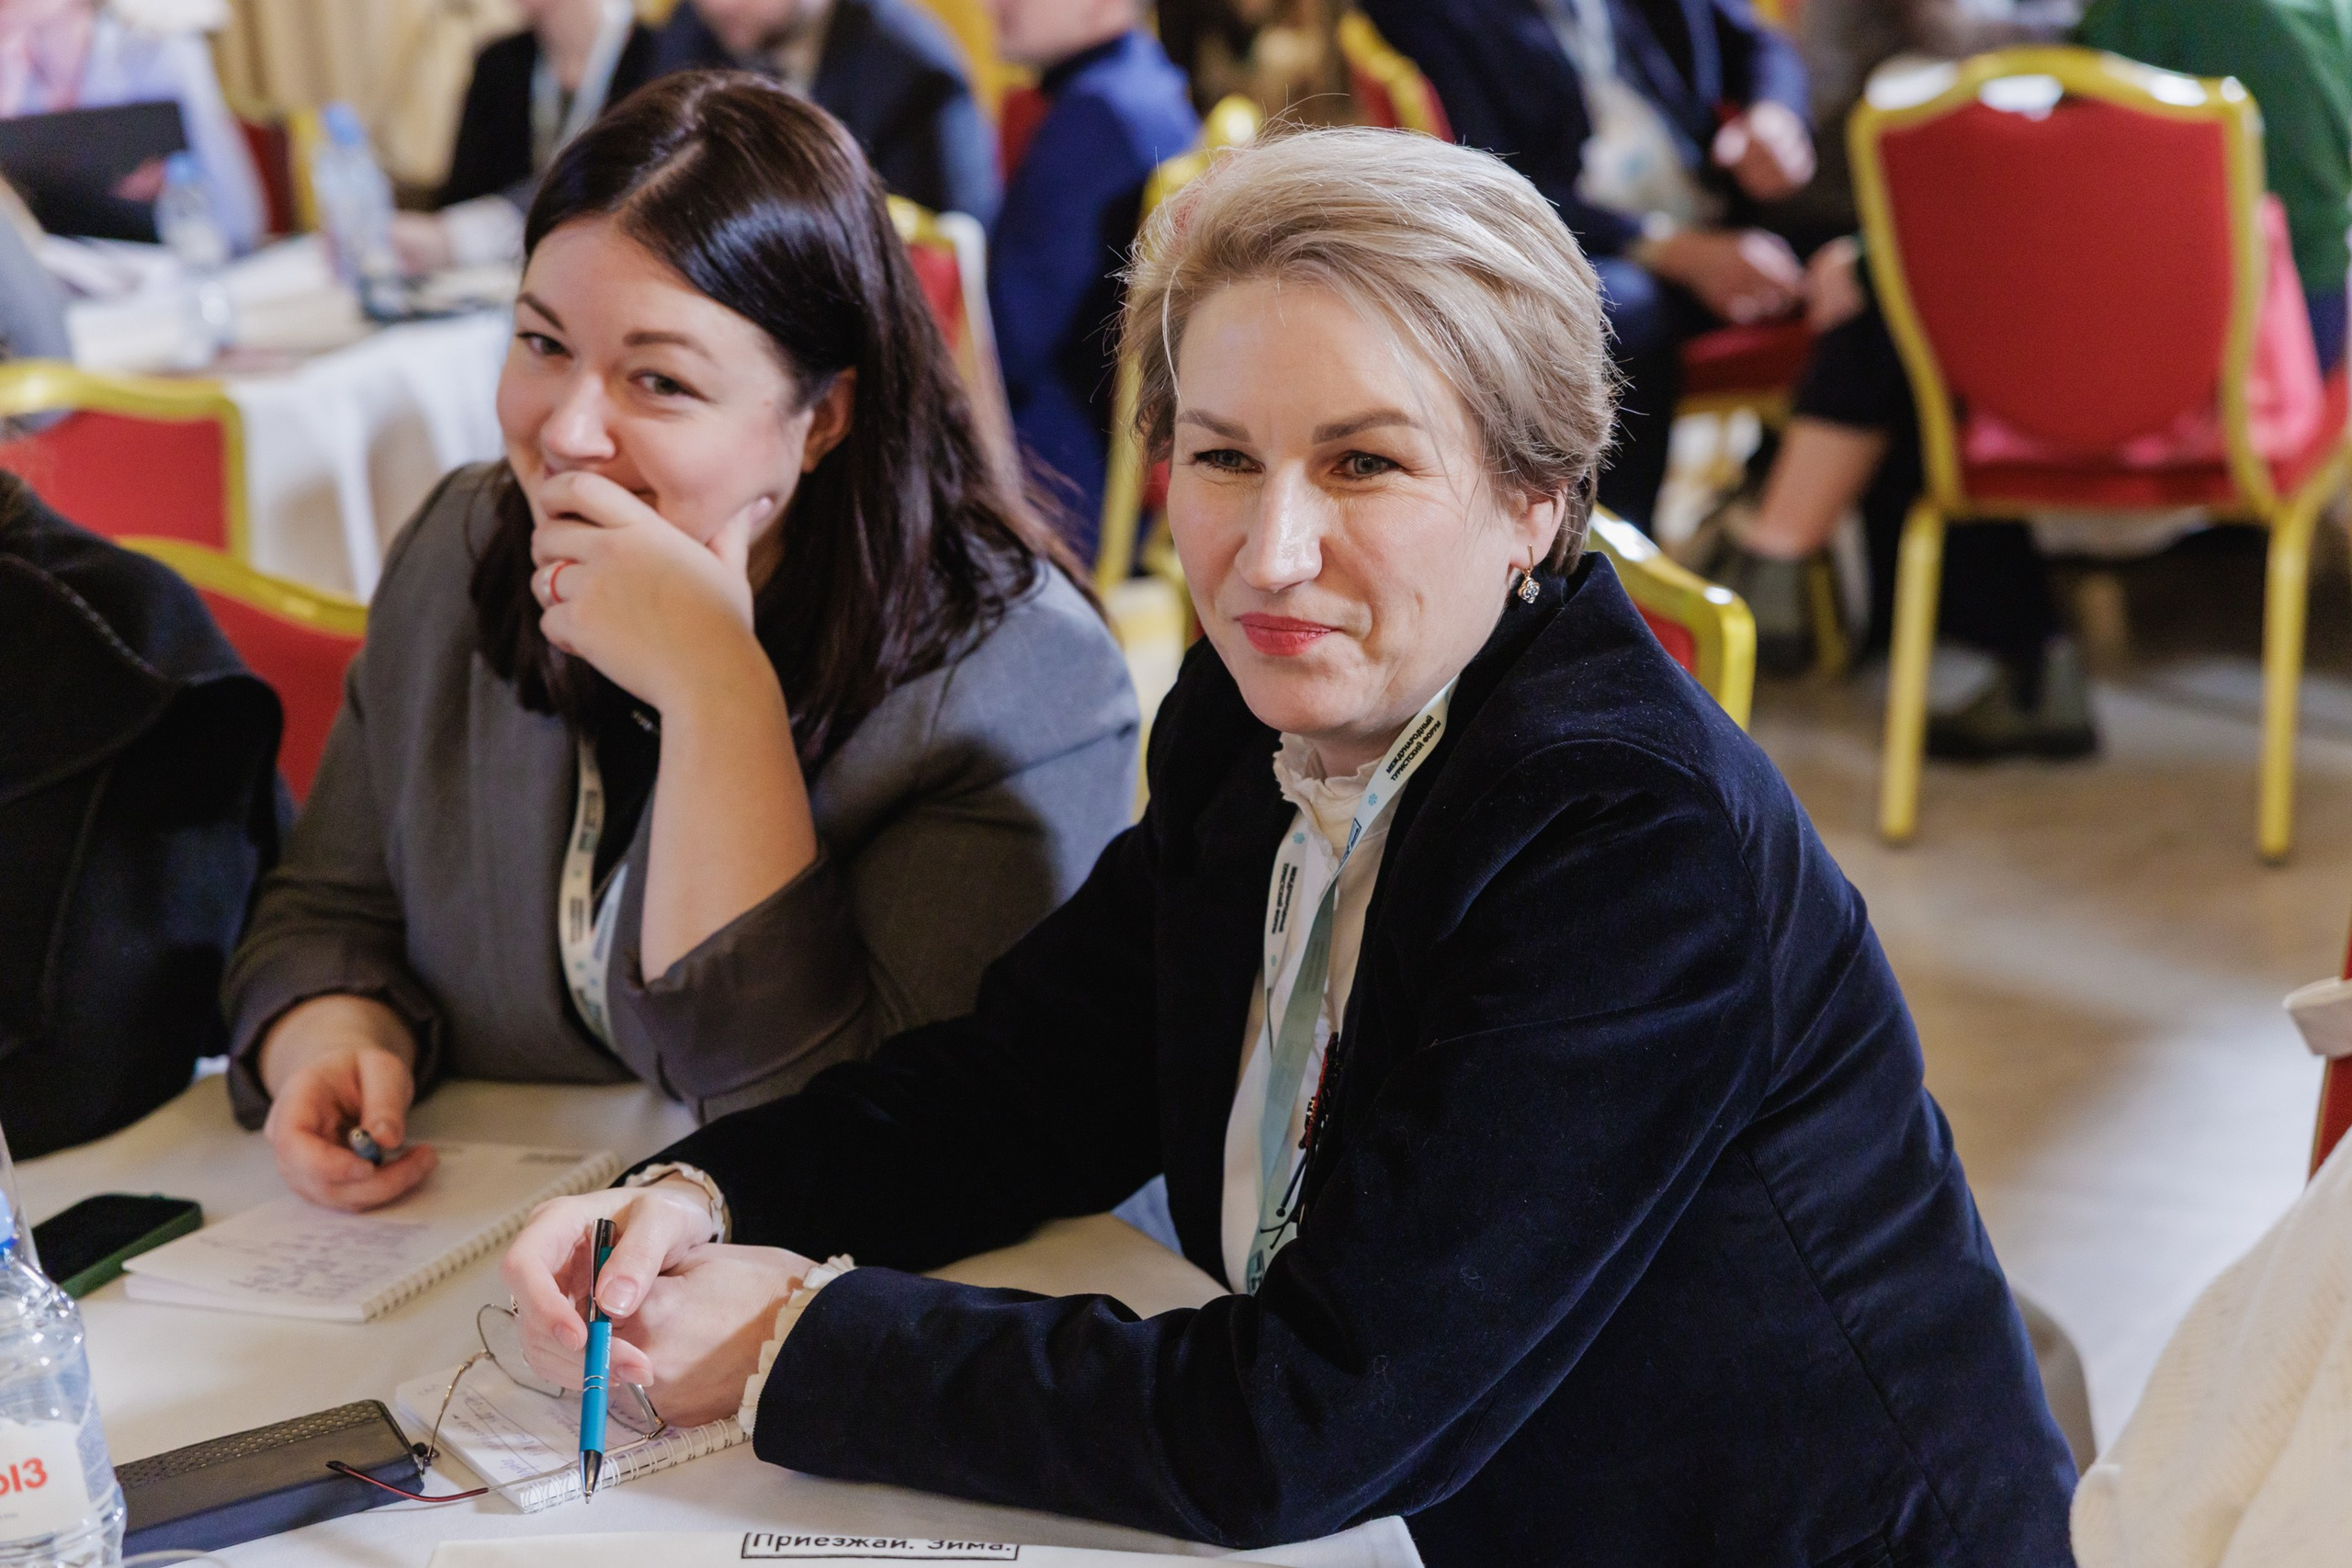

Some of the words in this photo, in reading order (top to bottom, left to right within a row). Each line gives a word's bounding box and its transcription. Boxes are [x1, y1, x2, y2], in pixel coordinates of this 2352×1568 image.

[1385, 715, 1434, 773] МЕЖДУНАРОДНЫЙ
[1390, 741, 1424, 781] ТУРИСТСКИЙ
[1422, 720, 1442, 742] ФОРУМ
